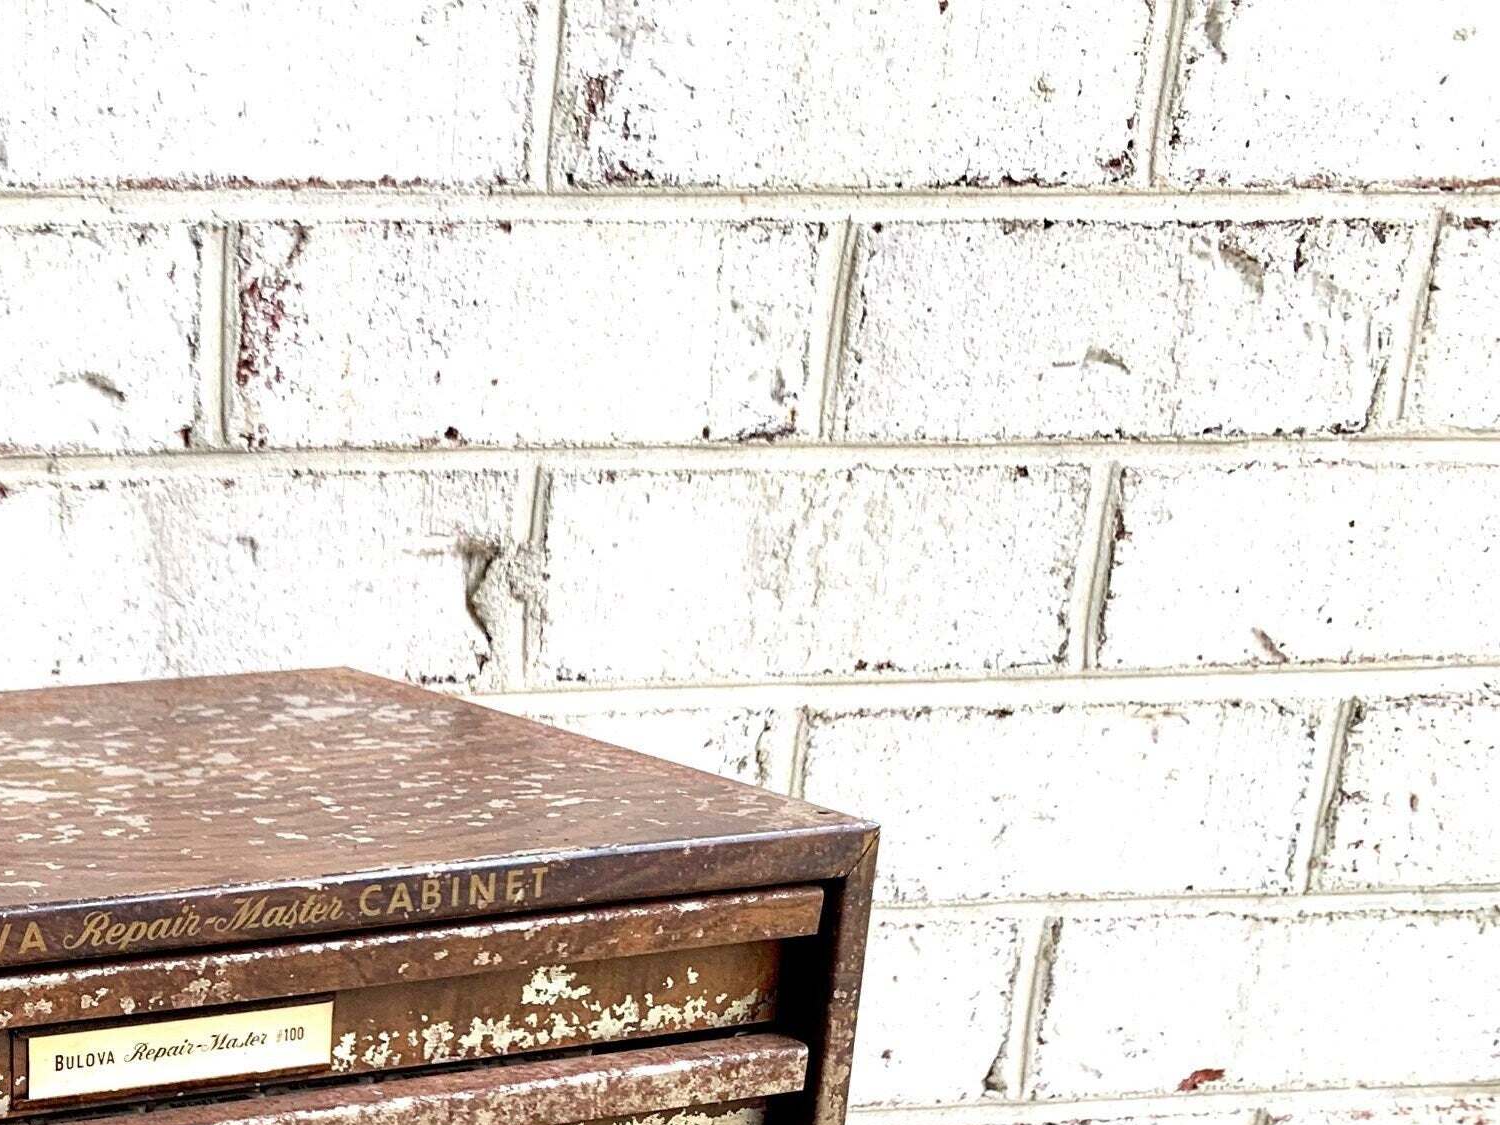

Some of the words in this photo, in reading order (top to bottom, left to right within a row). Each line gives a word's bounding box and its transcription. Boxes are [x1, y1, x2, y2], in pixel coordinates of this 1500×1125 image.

[62, 895, 344, 952] Repair-Master
[359, 865, 550, 919] CABINET
[54, 1051, 115, 1072] BULOVA
[124, 1031, 268, 1063] Repair-Master
